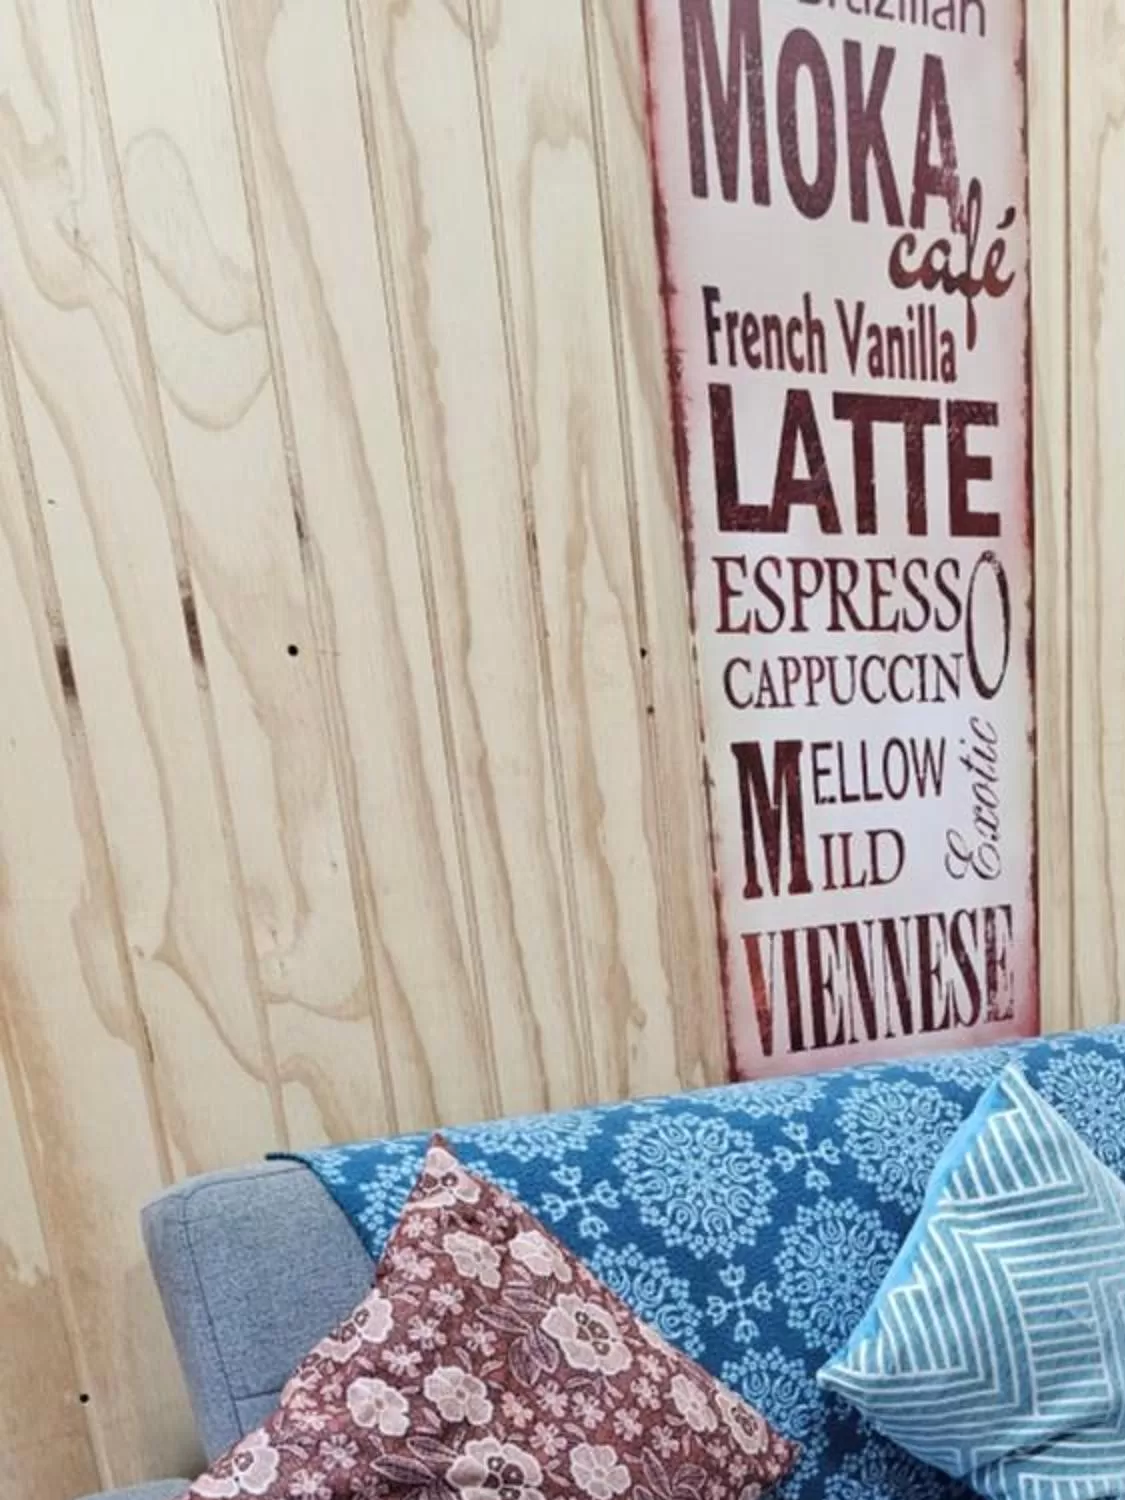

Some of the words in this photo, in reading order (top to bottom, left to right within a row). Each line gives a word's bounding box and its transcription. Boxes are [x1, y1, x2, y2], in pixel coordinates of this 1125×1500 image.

[796, 0, 986, 37] zilian
[680, 0, 968, 234] MOKA
[702, 285, 827, 374] French
[834, 297, 957, 383] Vanilla
[888, 178, 1016, 351] café
[708, 383, 1000, 537] LATTE
[712, 550, 1011, 699] ESPRESSO
[944, 715, 1001, 881] Exotic
[740, 904, 1015, 1057] VIENNESE
